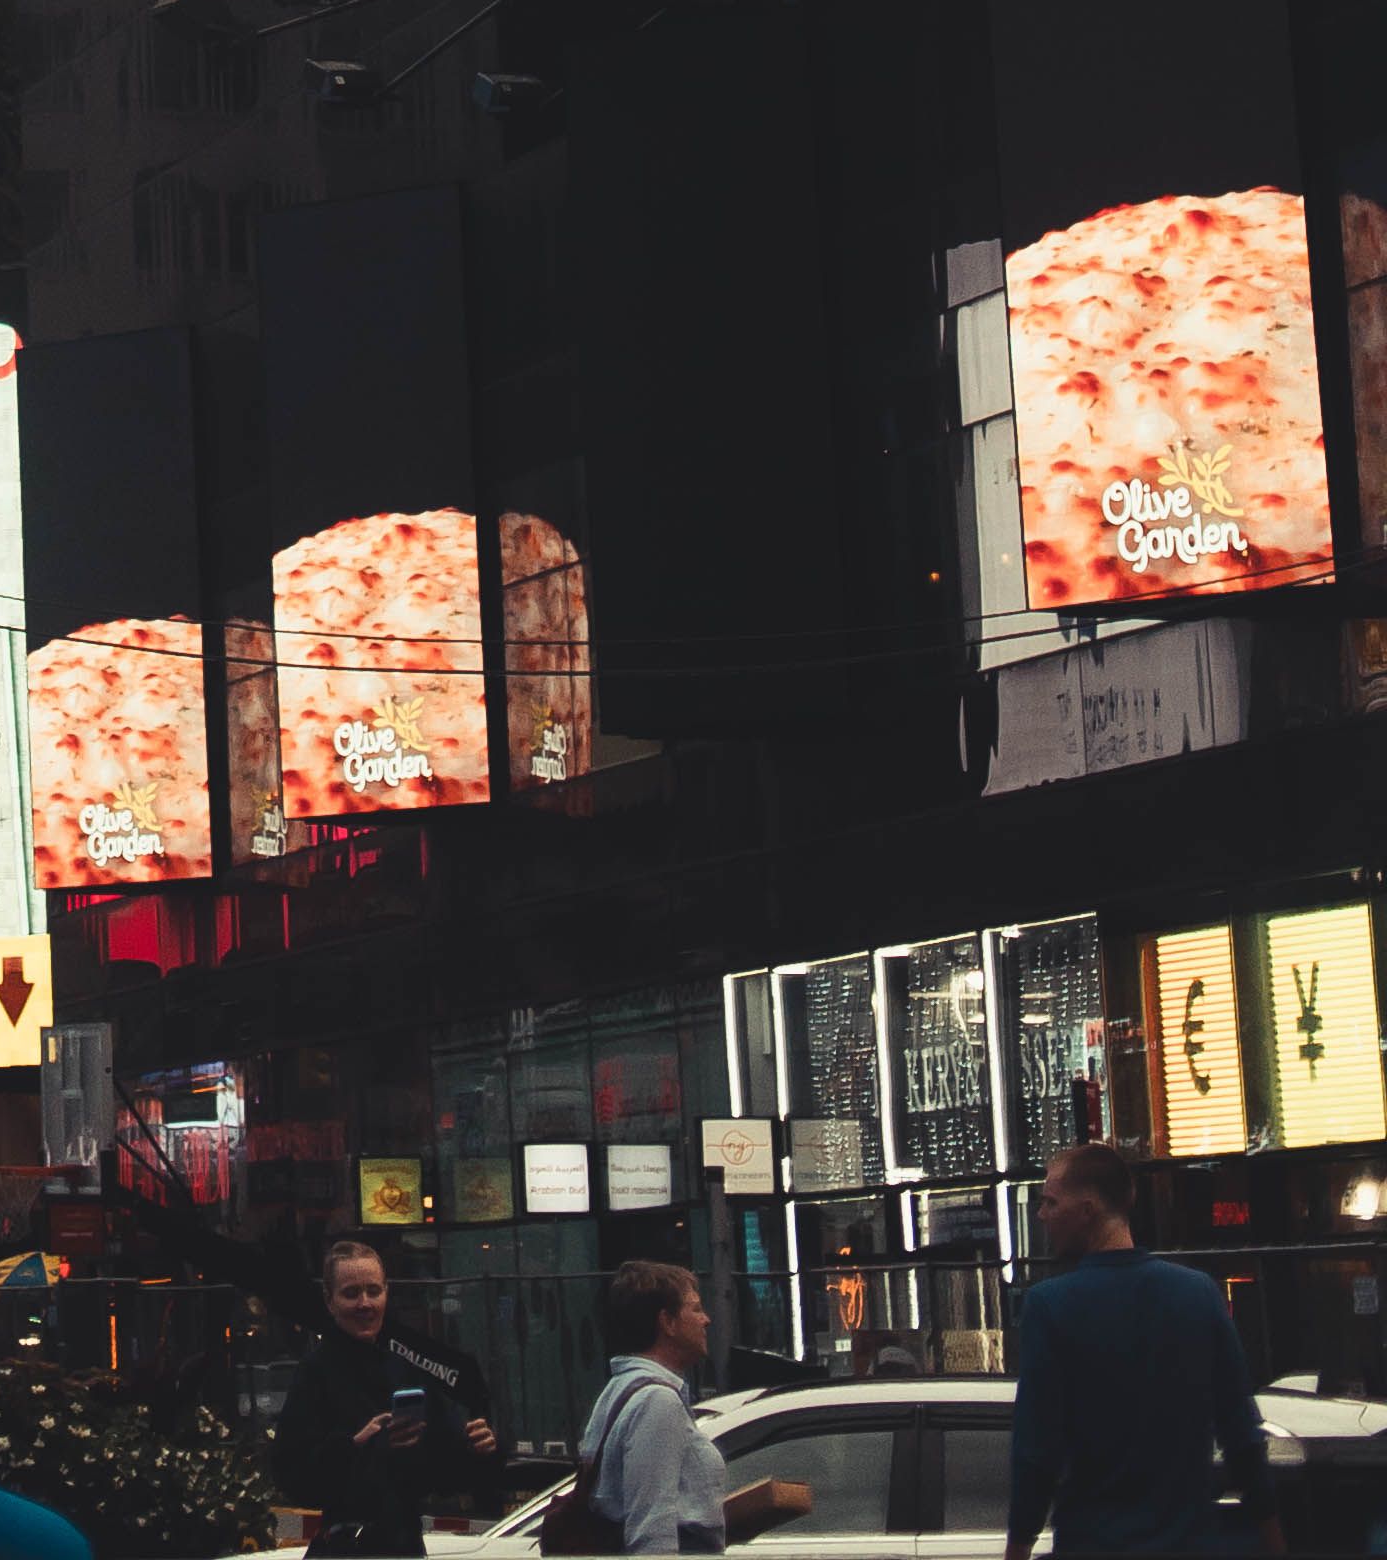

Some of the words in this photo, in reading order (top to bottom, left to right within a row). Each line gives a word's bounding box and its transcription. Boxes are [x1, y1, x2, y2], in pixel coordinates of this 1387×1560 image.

[1101, 477, 1193, 528] Olive
[1116, 514, 1248, 573] Garden
[332, 720, 395, 759] Olive
[342, 750, 433, 793] Garden
[78, 802, 133, 837] Olive
[86, 829, 165, 867] Garden
